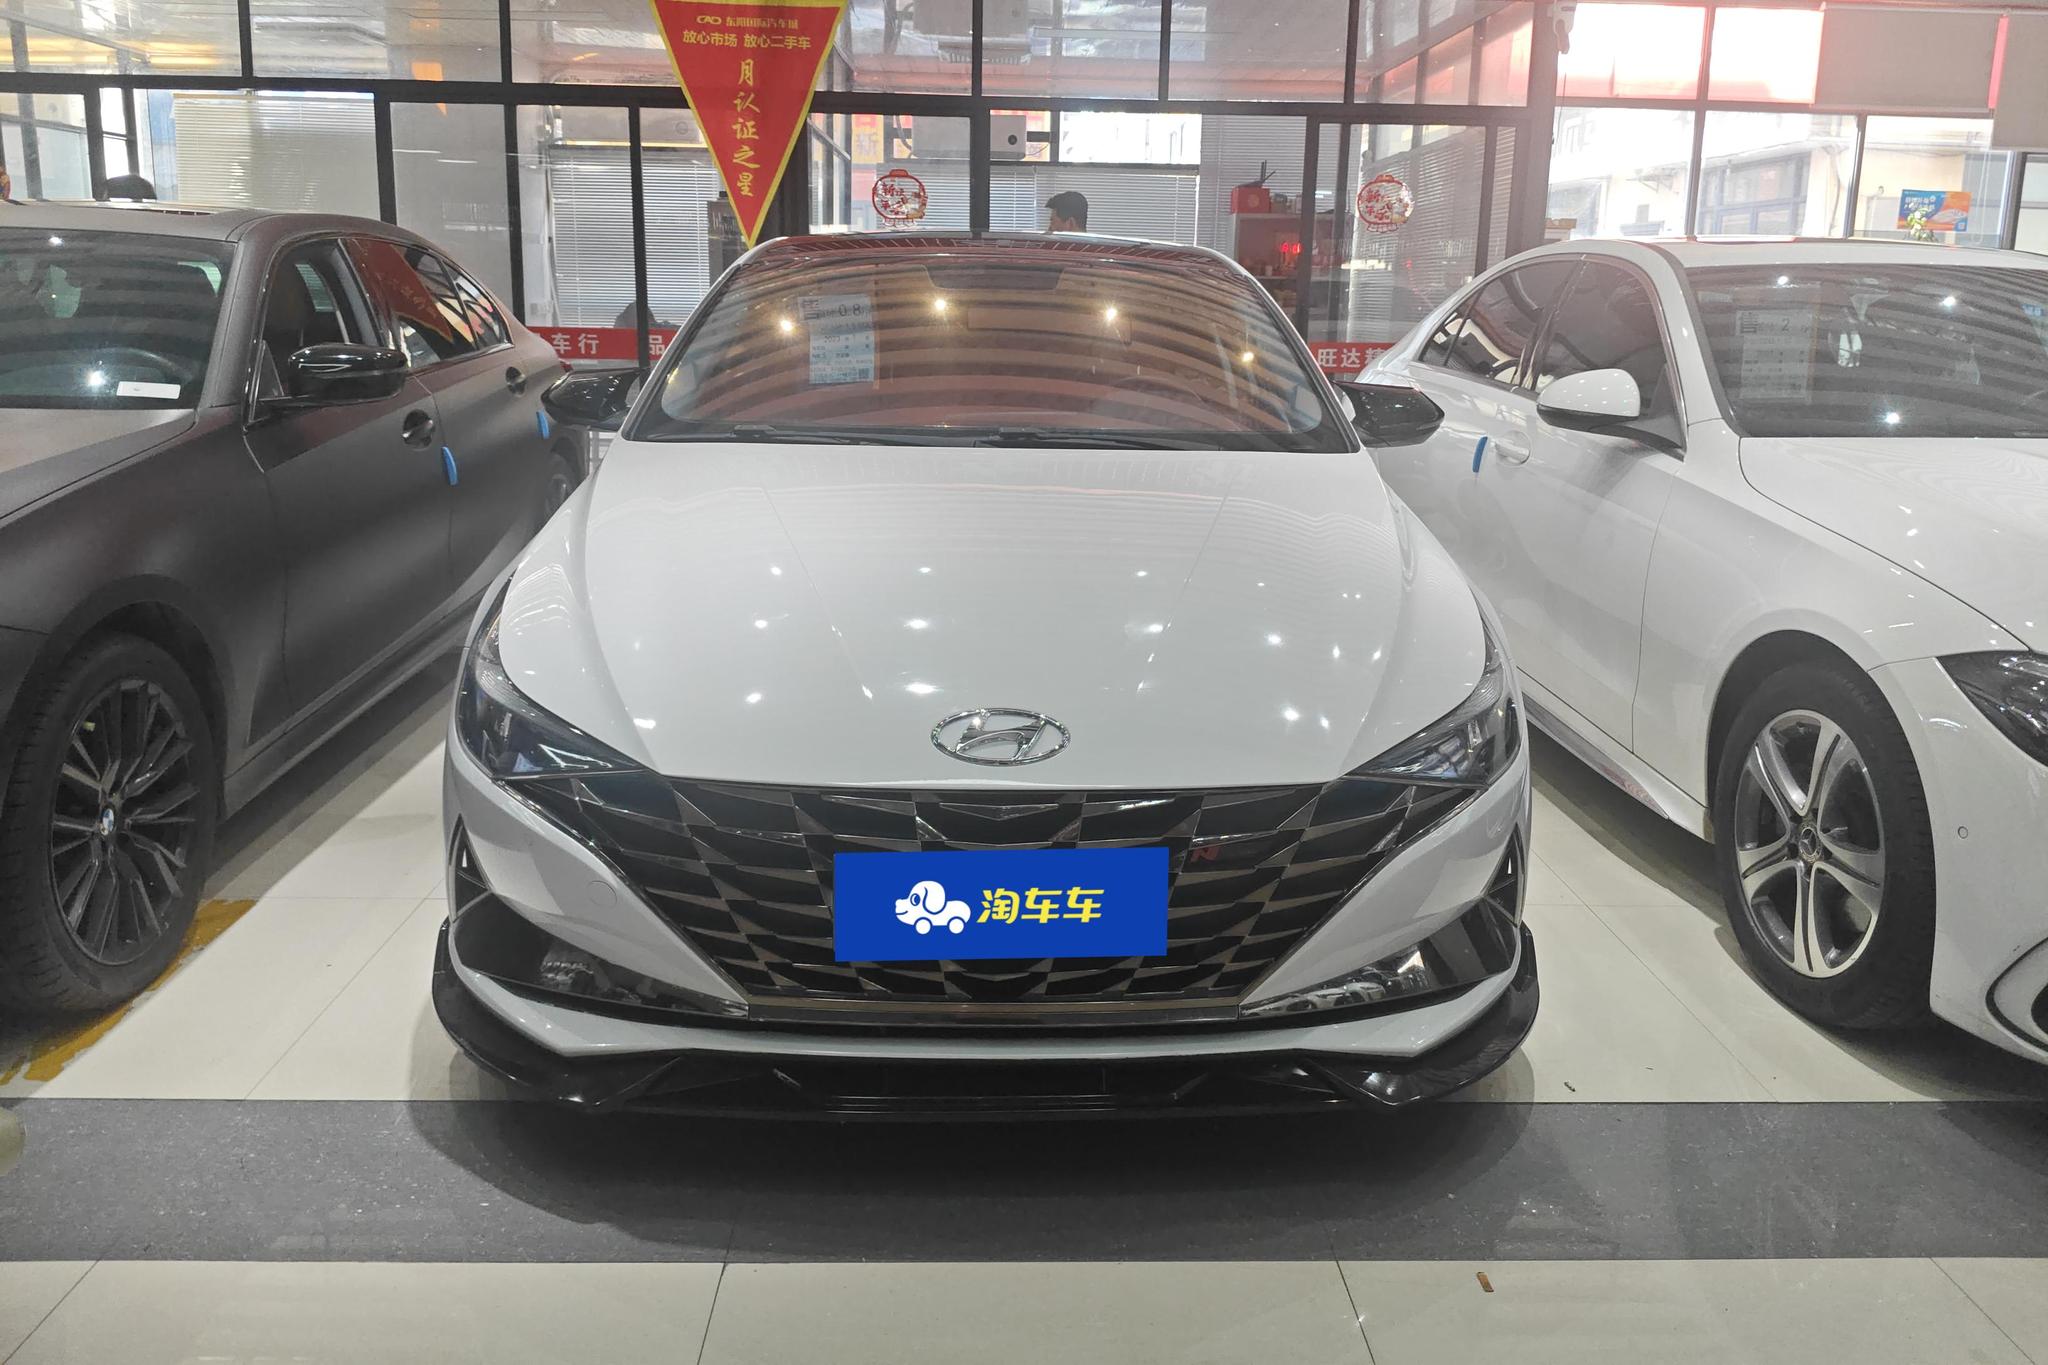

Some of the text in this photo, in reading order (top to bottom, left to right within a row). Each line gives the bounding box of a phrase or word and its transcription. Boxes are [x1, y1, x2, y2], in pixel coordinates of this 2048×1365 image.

[683, 30, 812, 50] 放心市场 放心二手车
[732, 58, 761, 197] 月认证之星
